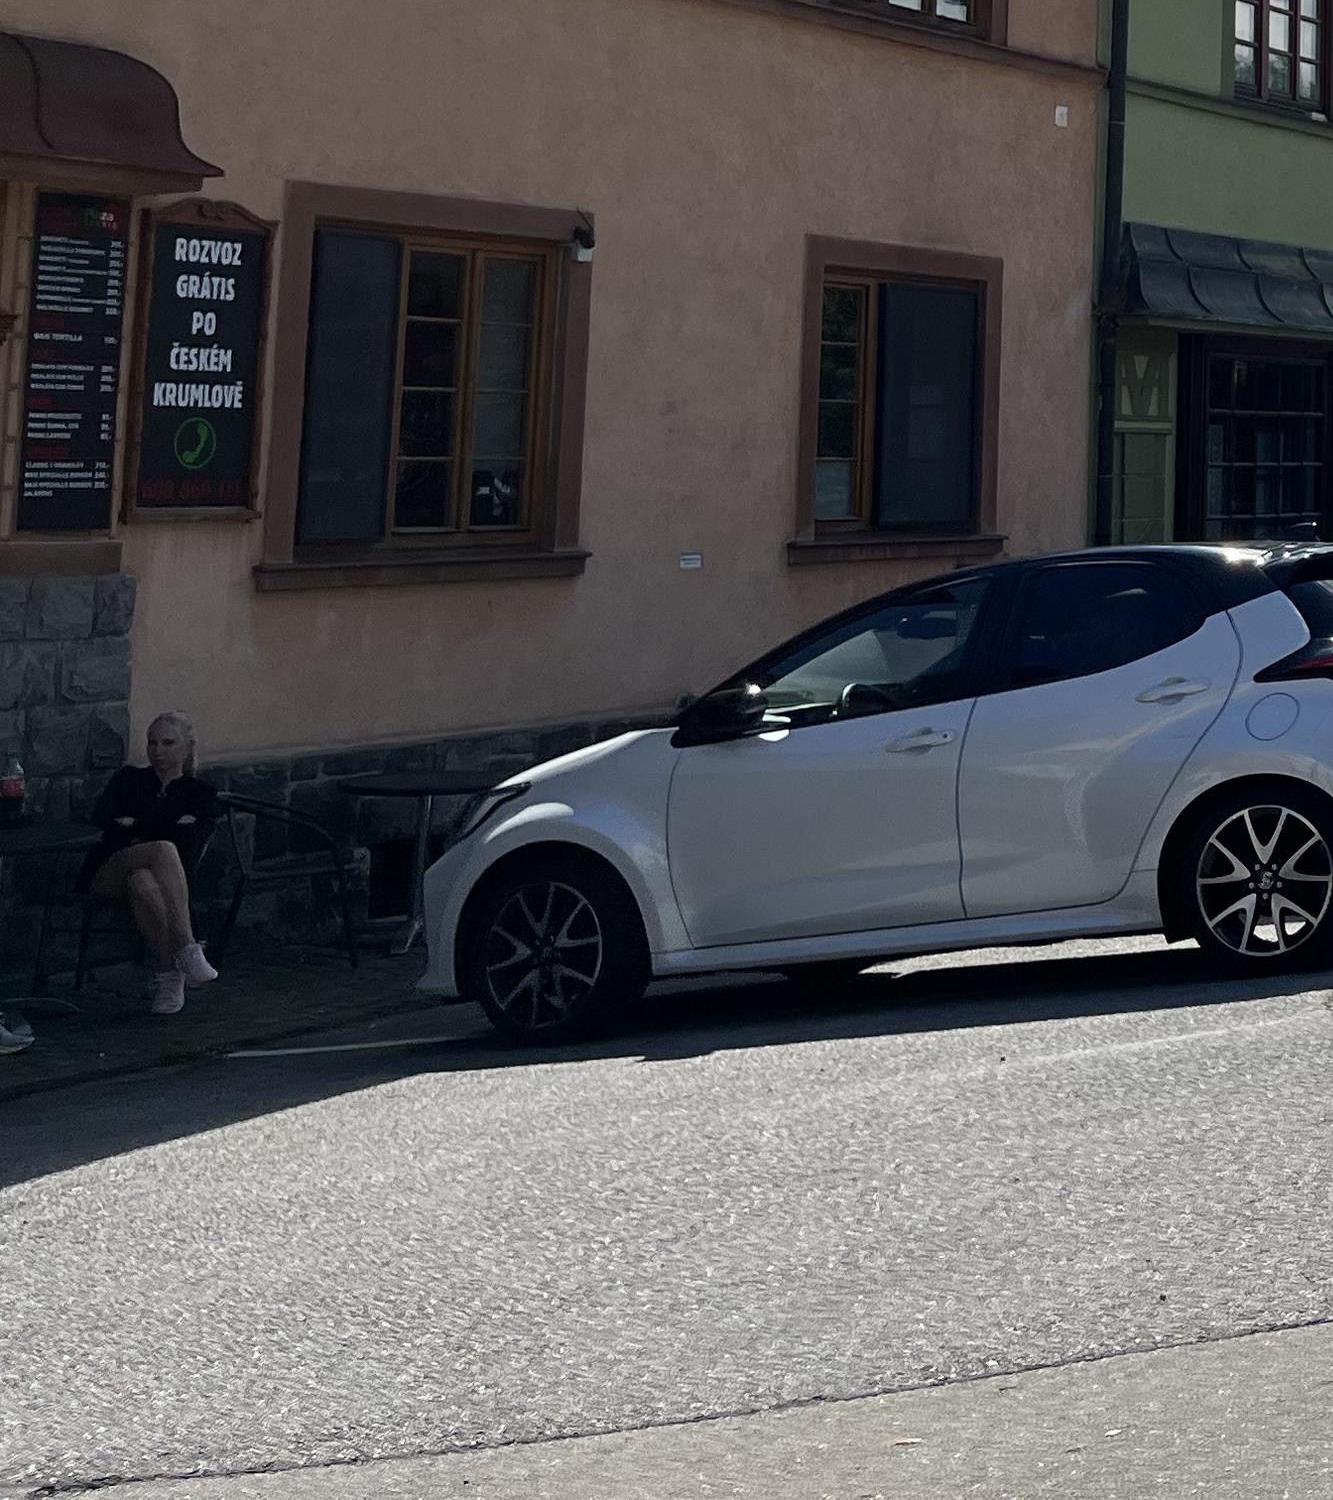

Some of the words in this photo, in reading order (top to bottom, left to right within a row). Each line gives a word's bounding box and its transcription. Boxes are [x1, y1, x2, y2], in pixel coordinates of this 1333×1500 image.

[174, 237, 242, 266] ROZVOZ
[176, 271, 236, 302] GRÁTIS
[191, 311, 216, 337] PO
[169, 344, 232, 373] ČESKÉM
[152, 380, 243, 409] KRUMLOVĚ
